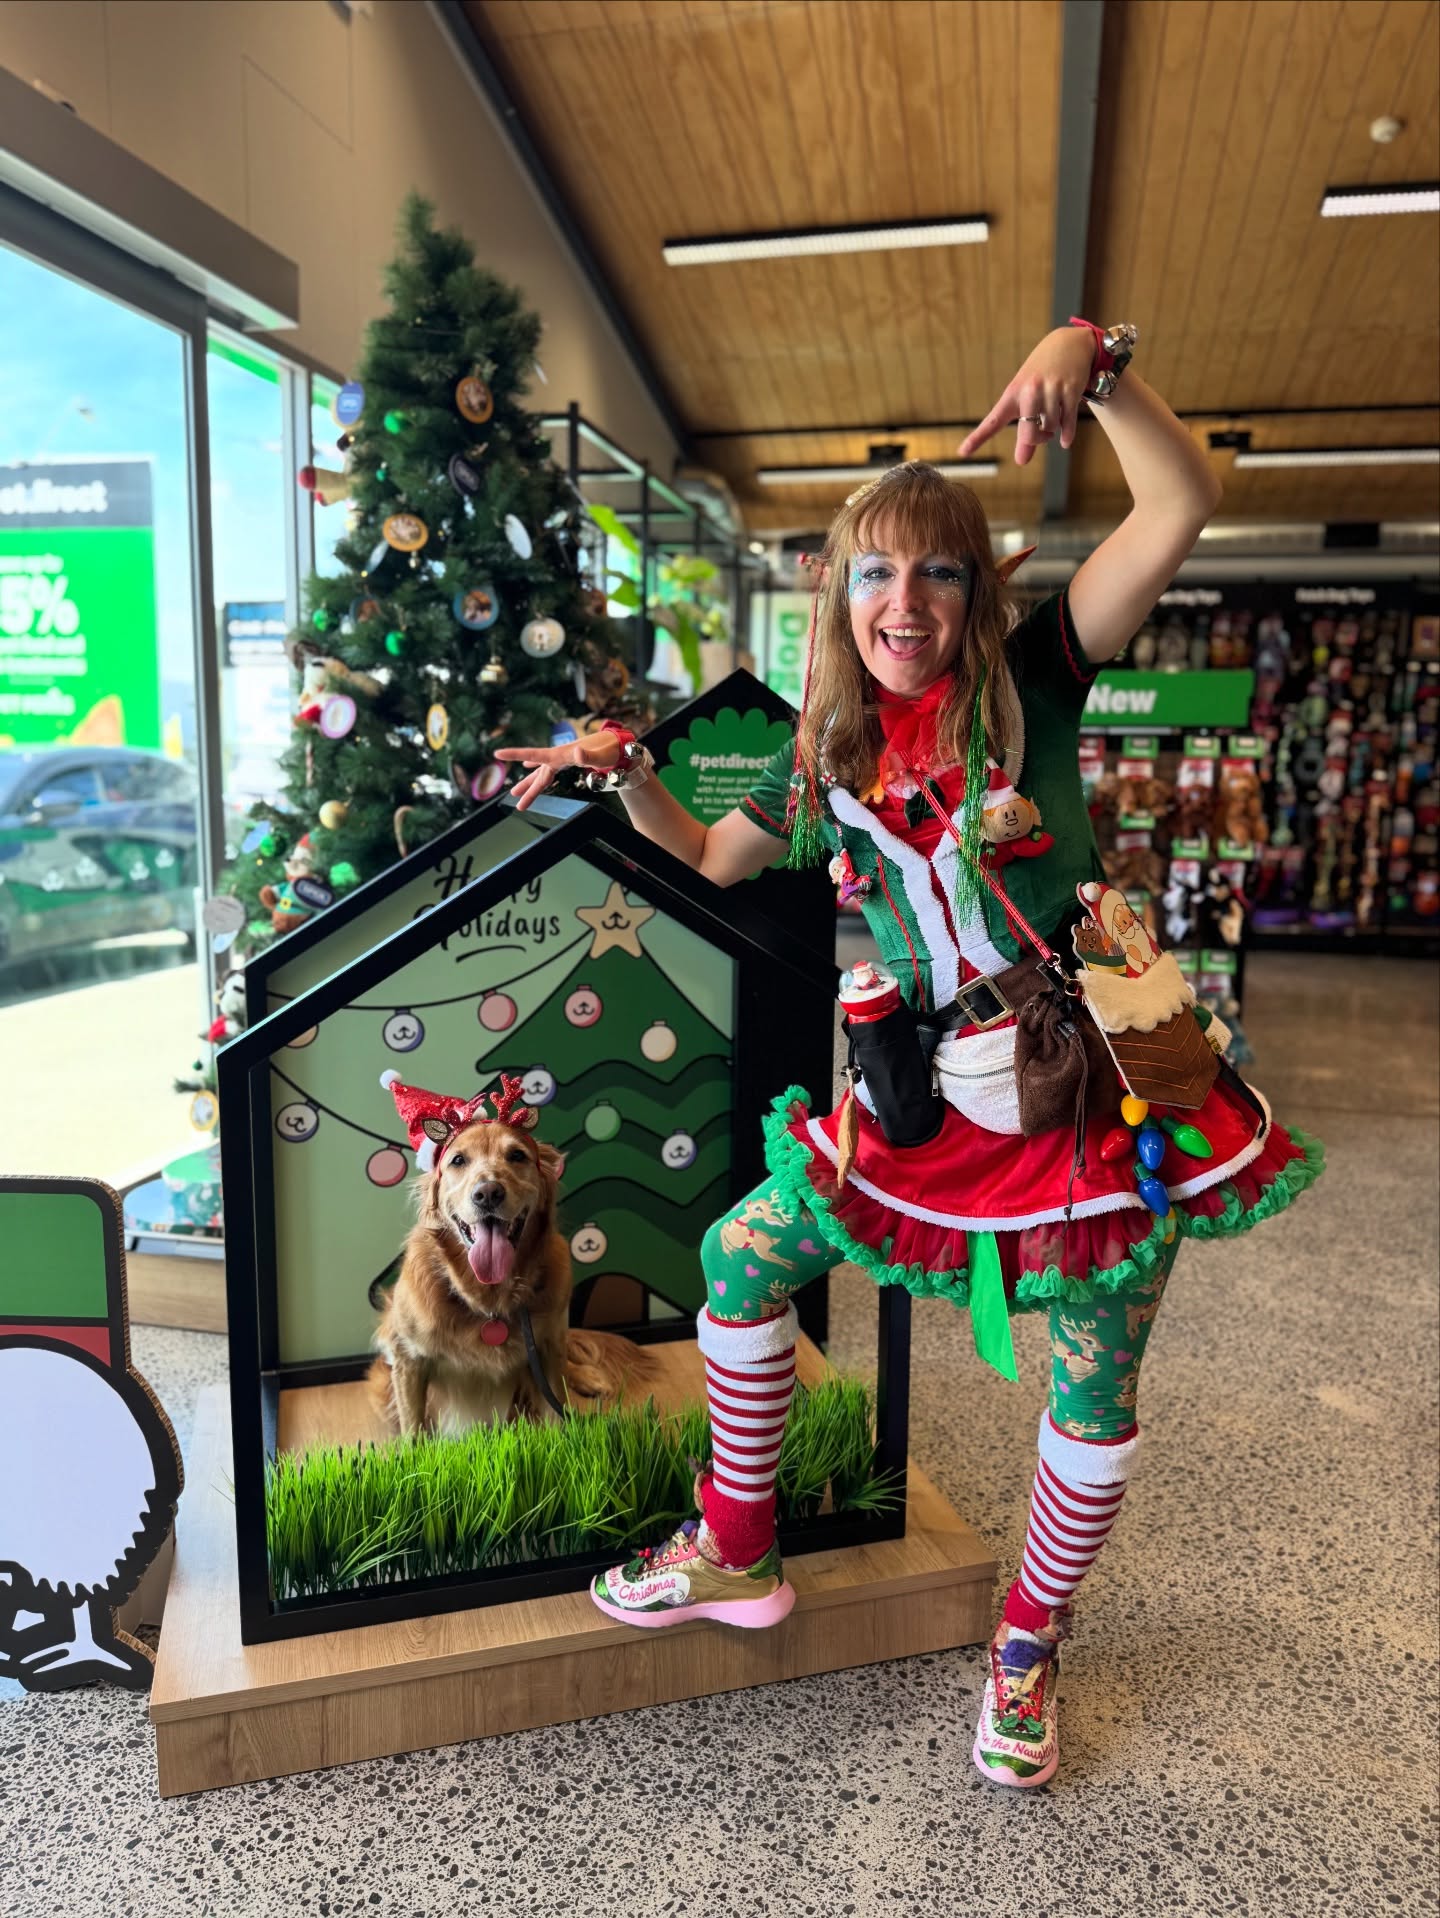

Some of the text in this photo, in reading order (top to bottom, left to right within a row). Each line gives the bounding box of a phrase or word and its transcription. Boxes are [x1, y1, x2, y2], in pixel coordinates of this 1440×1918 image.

[1085, 683, 1157, 714] New
[690, 753, 776, 771] #petdirect
[414, 904, 560, 950] olidays
[619, 1578, 677, 1603] Christmas
[990, 1737, 1010, 1751] the
